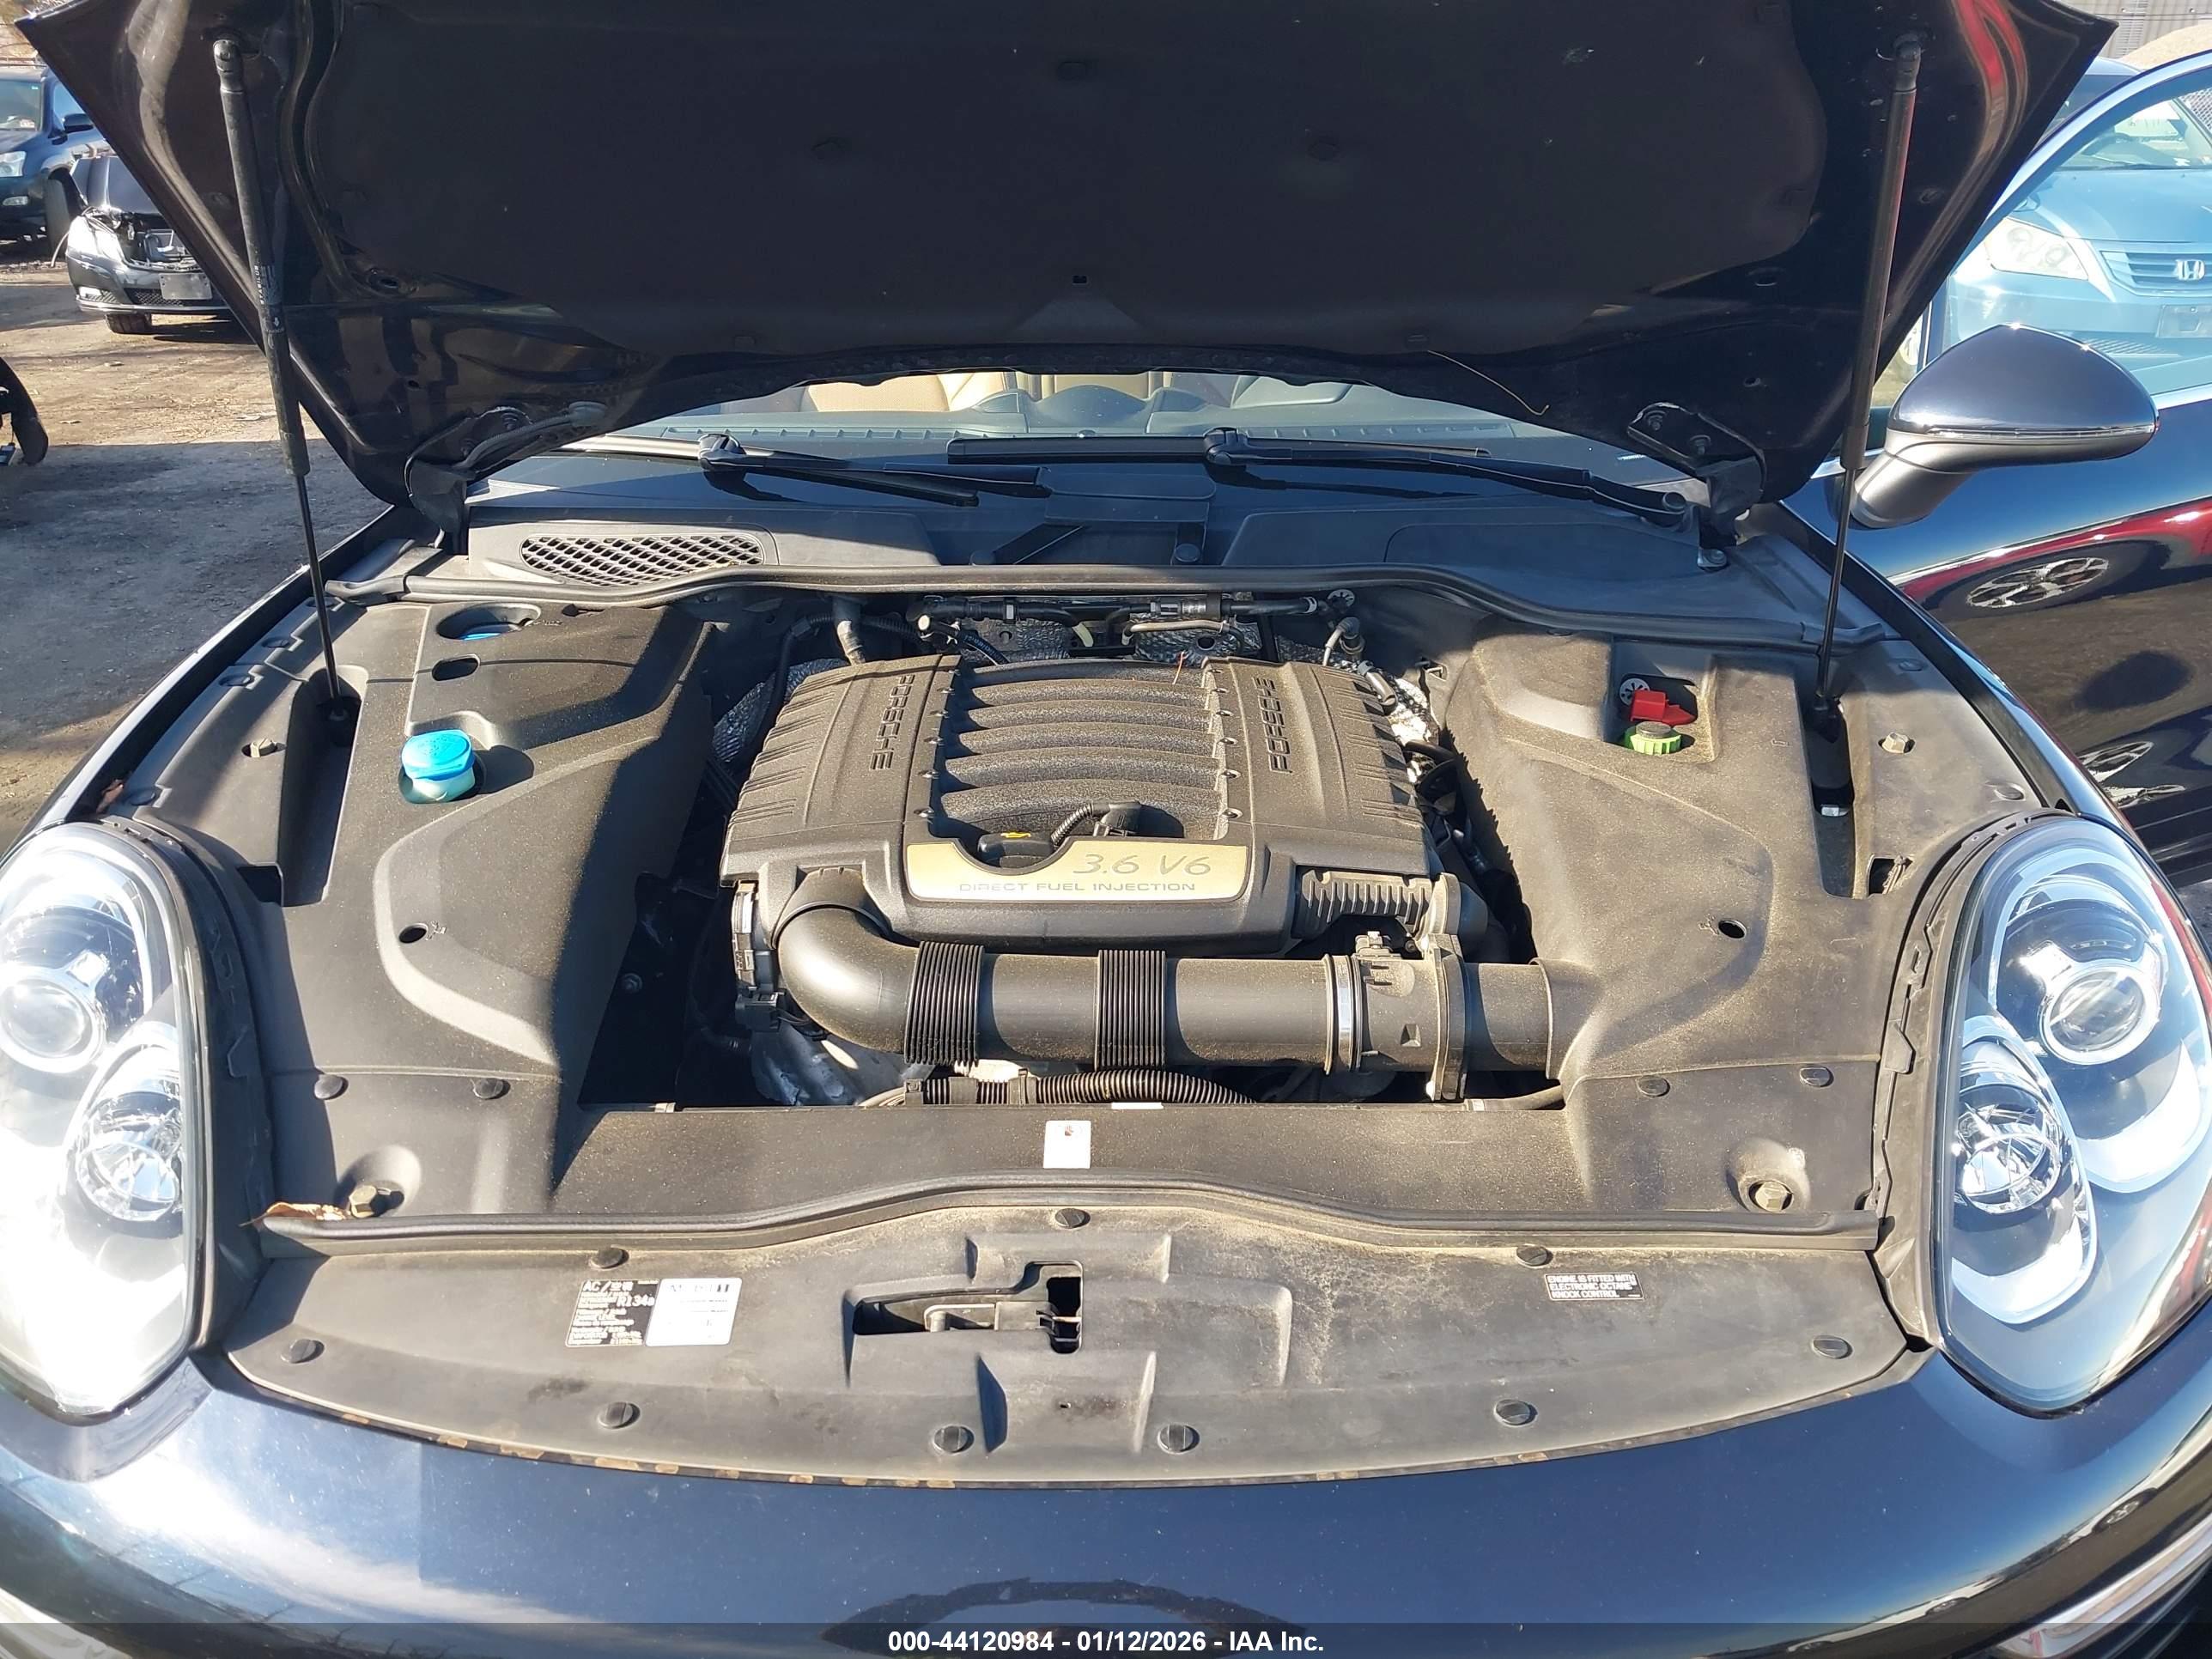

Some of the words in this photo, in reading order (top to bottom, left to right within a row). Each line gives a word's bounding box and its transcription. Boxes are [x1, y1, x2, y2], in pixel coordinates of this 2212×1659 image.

[869, 674, 915, 771] PORSCHE
[1252, 677, 1293, 775] PORSCHE
[959, 883, 1029, 891] DIRECT
[1092, 883, 1195, 891] INJECTION
[1073, 854, 1139, 874] 3.6
[1159, 854, 1212, 875] V6
